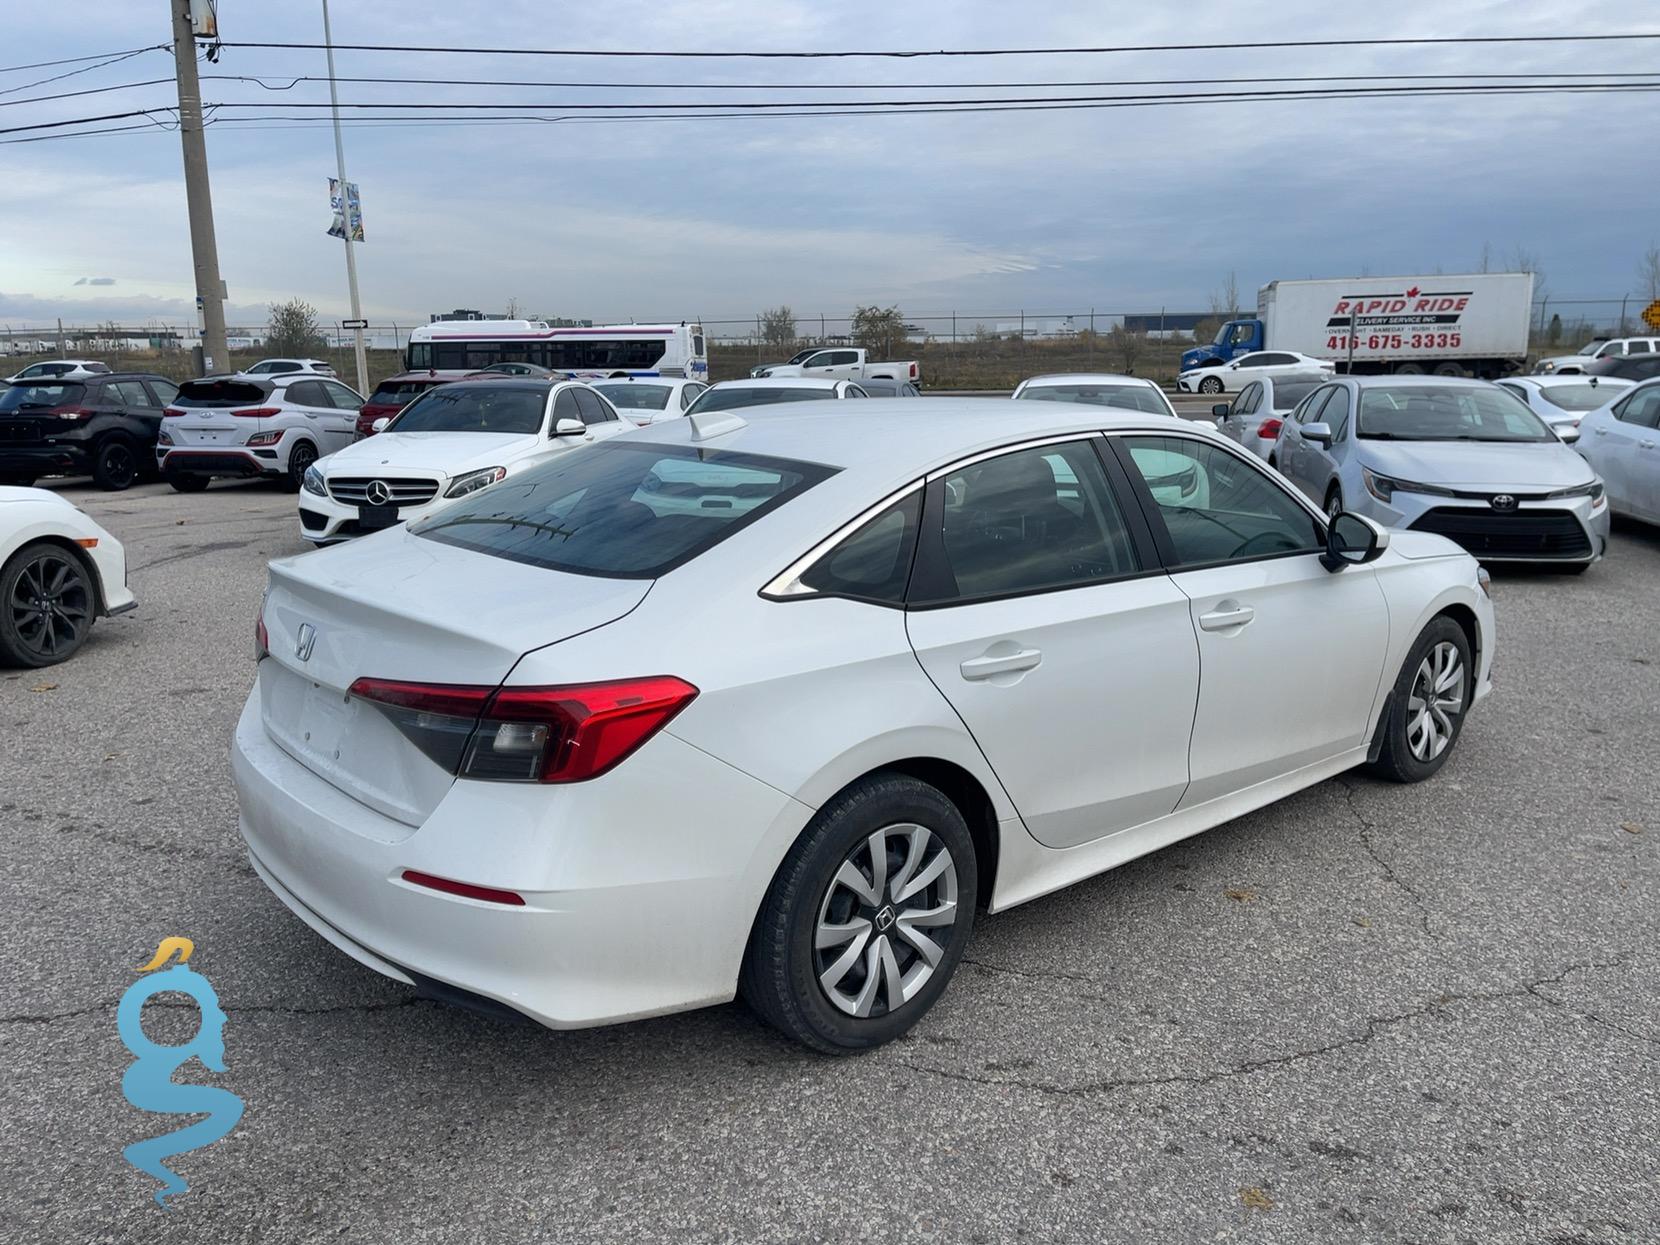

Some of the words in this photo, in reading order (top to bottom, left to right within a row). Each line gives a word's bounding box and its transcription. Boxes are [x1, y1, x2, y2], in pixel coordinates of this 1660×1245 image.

[1333, 300, 1407, 315] RAPID
[1413, 298, 1469, 312] RIDE
[1353, 317, 1387, 325] ELIVERY
[1389, 316, 1421, 325] SERVICE
[1327, 333, 1461, 350] 416-675-3335
